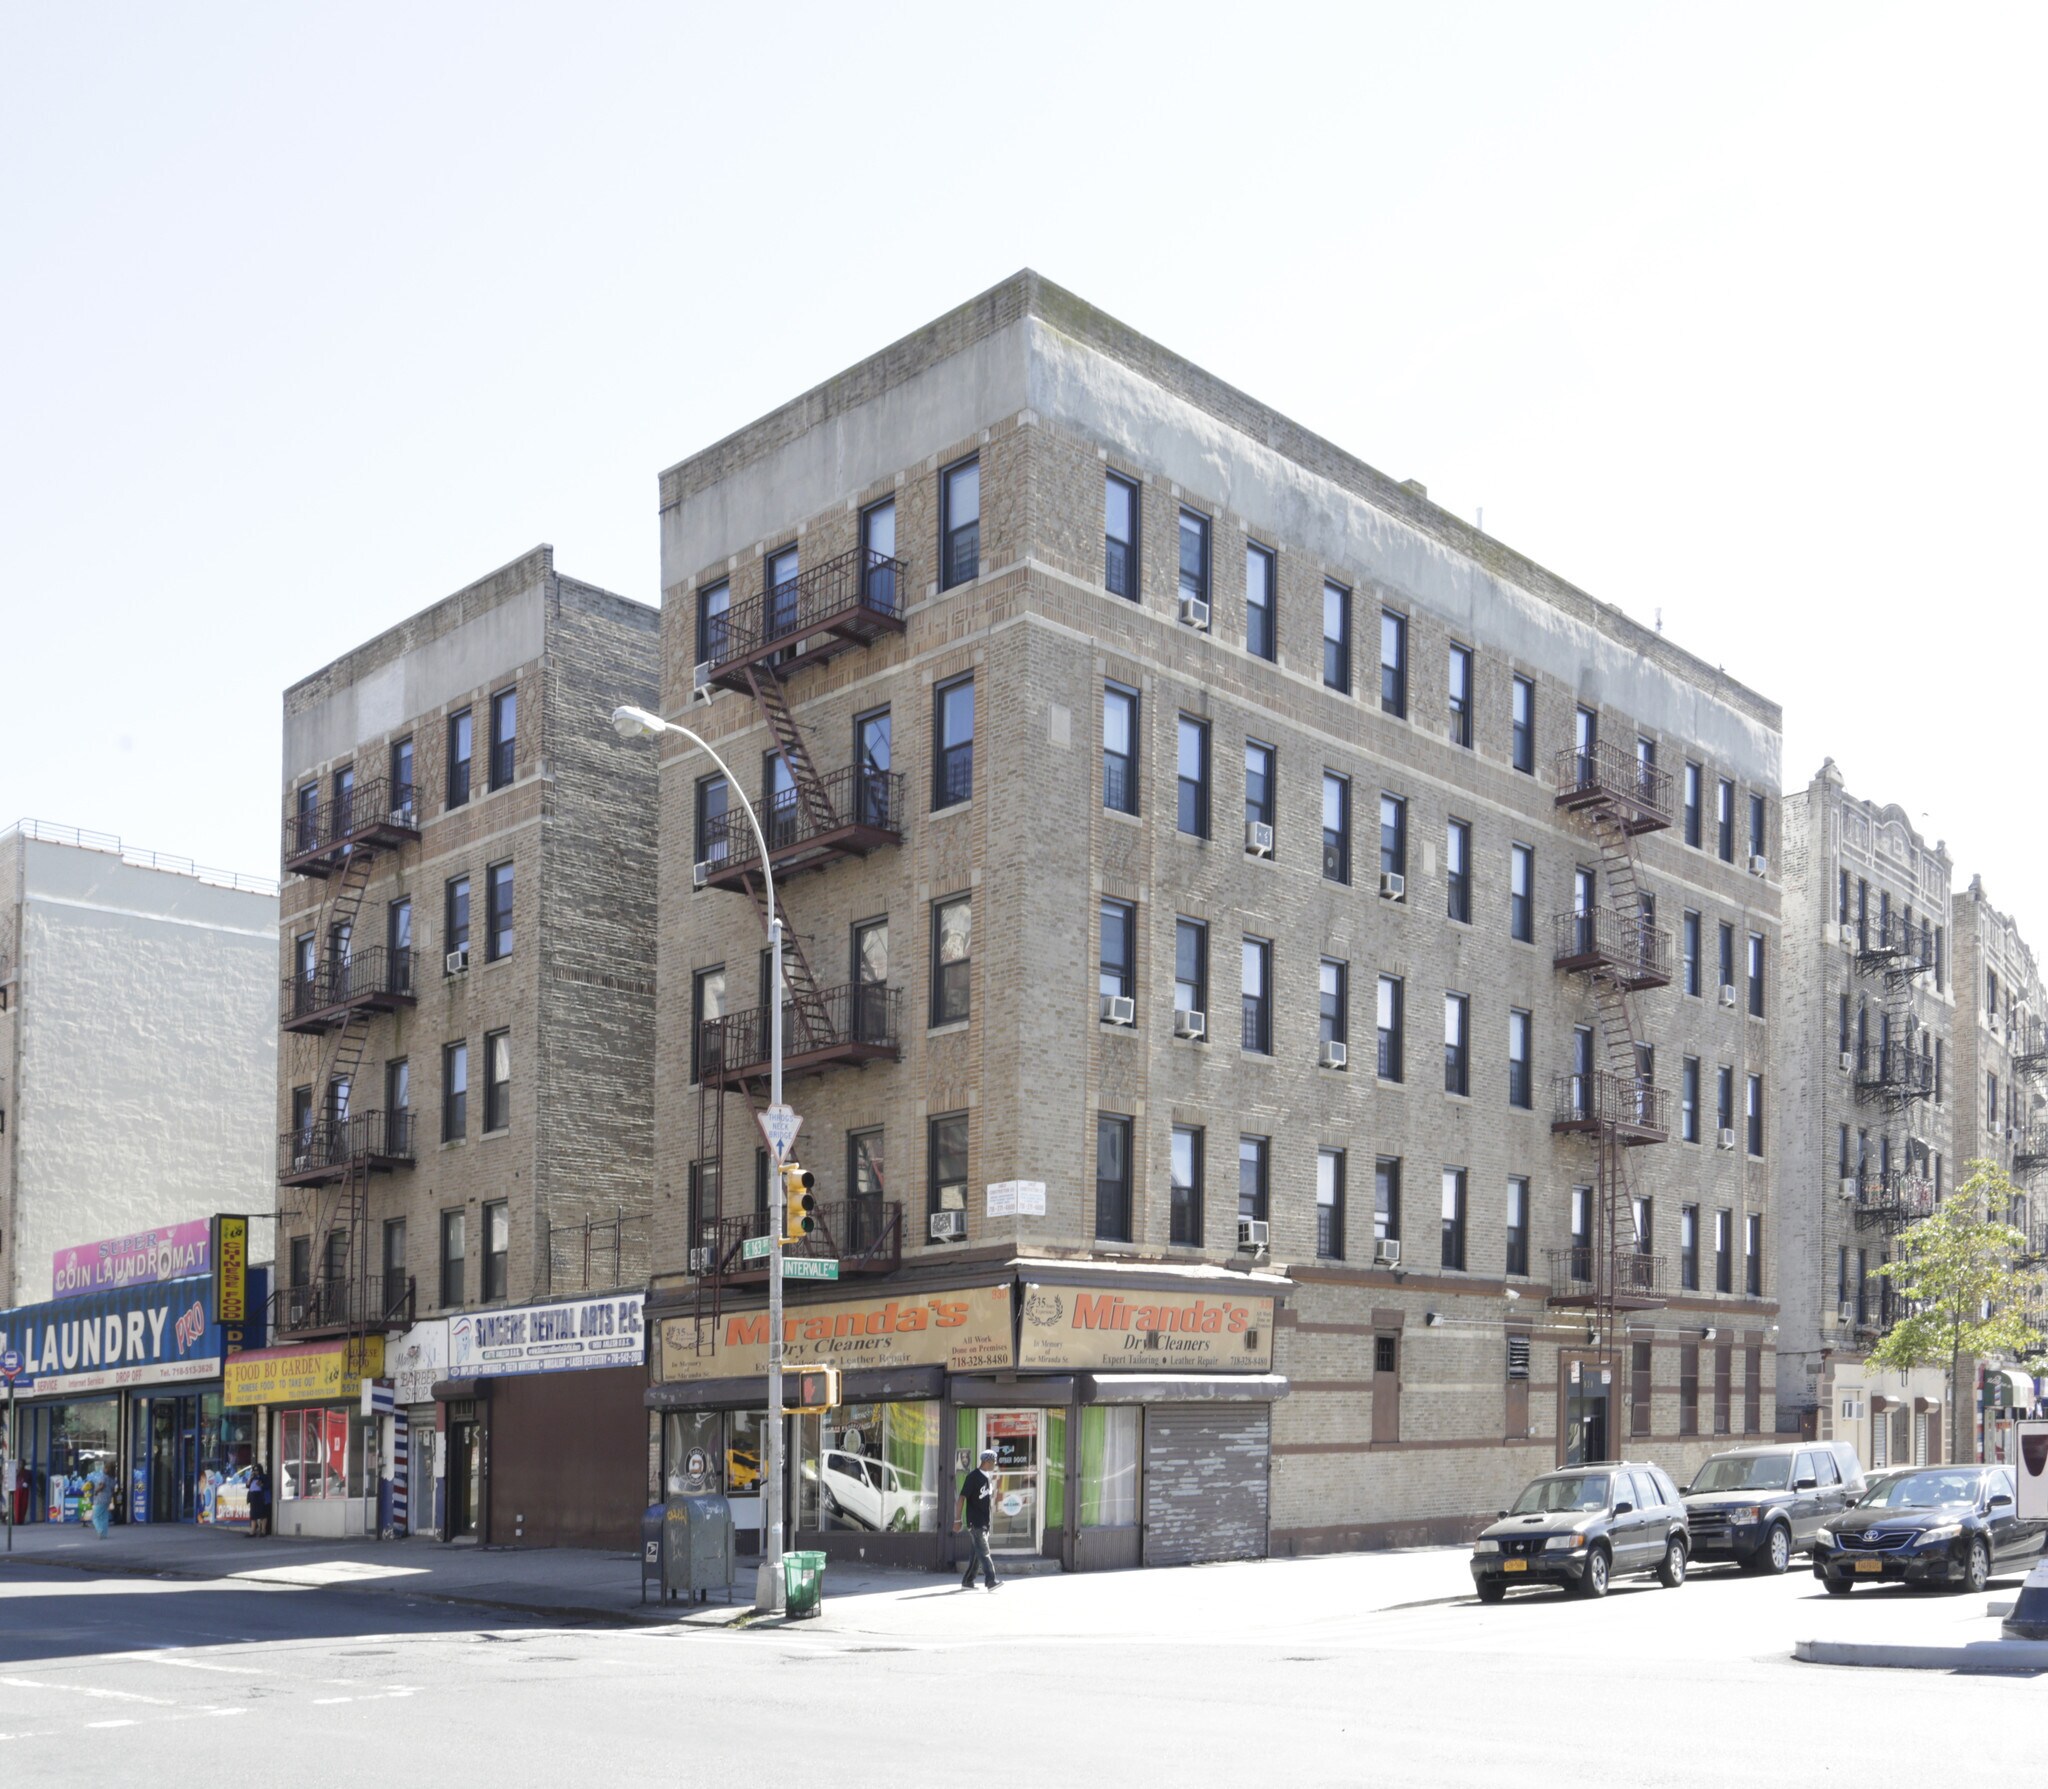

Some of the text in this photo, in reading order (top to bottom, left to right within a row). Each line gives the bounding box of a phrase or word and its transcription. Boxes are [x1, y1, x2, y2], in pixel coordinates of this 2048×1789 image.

[768, 1130, 793, 1140] BRIDGE
[99, 1232, 158, 1258] SUPER
[745, 1243, 750, 1257] E
[751, 1239, 762, 1255] 163
[55, 1241, 207, 1291] COIN LAUNDROMAT
[223, 1241, 241, 1288] CHINESE
[784, 1261, 837, 1277] INTERVALE AV
[222, 1290, 242, 1319] FOOD
[1036, 1297, 1046, 1308] 35
[725, 1298, 970, 1346] Mranda's
[1071, 1293, 1250, 1334] Miranda's
[175, 1301, 205, 1356] PRO
[475, 1313, 527, 1348] SINCERE
[530, 1307, 577, 1343] DENTAL
[579, 1303, 614, 1338] ARTS
[676, 1327, 686, 1336] 35
[25, 1306, 169, 1374] LAUNDRY
[814, 1336, 893, 1353] Cleaners
[963, 1335, 992, 1345] All Work
[1041, 1340, 1063, 1349] Memory
[1124, 1334, 1211, 1355] Dry Cleaners
[952, 1346, 967, 1355] Done
[978, 1344, 1008, 1353] Premises
[680, 1360, 702, 1369] Memory
[840, 1354, 876, 1365] Leather
[879, 1352, 912, 1364] Repair
[951, 1354, 1009, 1368] 718-328-8480
[1038, 1355, 1061, 1363] Miranda
[1102, 1353, 1218, 1367] Expert Tailoring Leather Repair
[235, 1357, 322, 1382] FOOD BO GARDEN
[37, 1379, 58, 1392] SERVICE
[116, 1371, 131, 1383] DROP
[131, 1368, 143, 1382] OFF
[237, 1376, 316, 1393] CHINESE FOOD TO TAKE OUT
[400, 1370, 438, 1387] BARBER
[404, 1386, 429, 1401] SHOP
